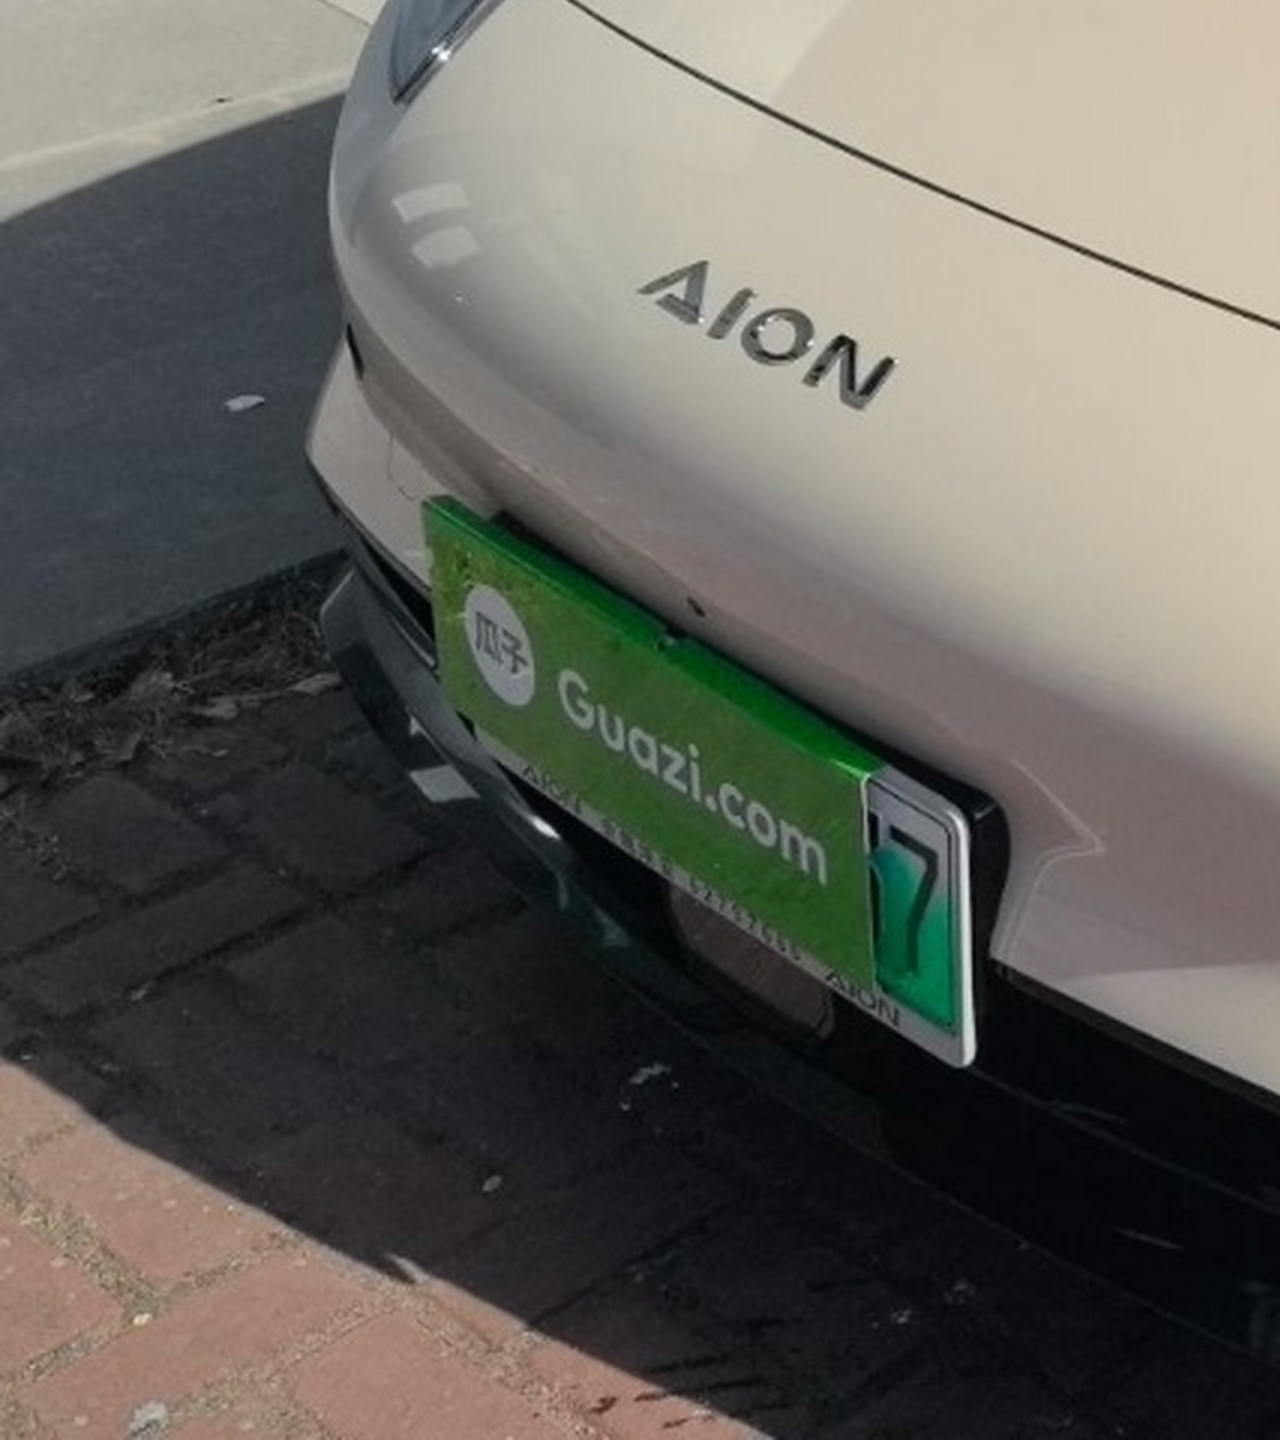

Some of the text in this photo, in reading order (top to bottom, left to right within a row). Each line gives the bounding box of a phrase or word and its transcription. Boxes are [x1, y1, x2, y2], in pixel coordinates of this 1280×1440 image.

[637, 260, 898, 411] AION
[475, 611, 528, 675] 瓜子
[557, 671, 829, 885] Guazi.com
